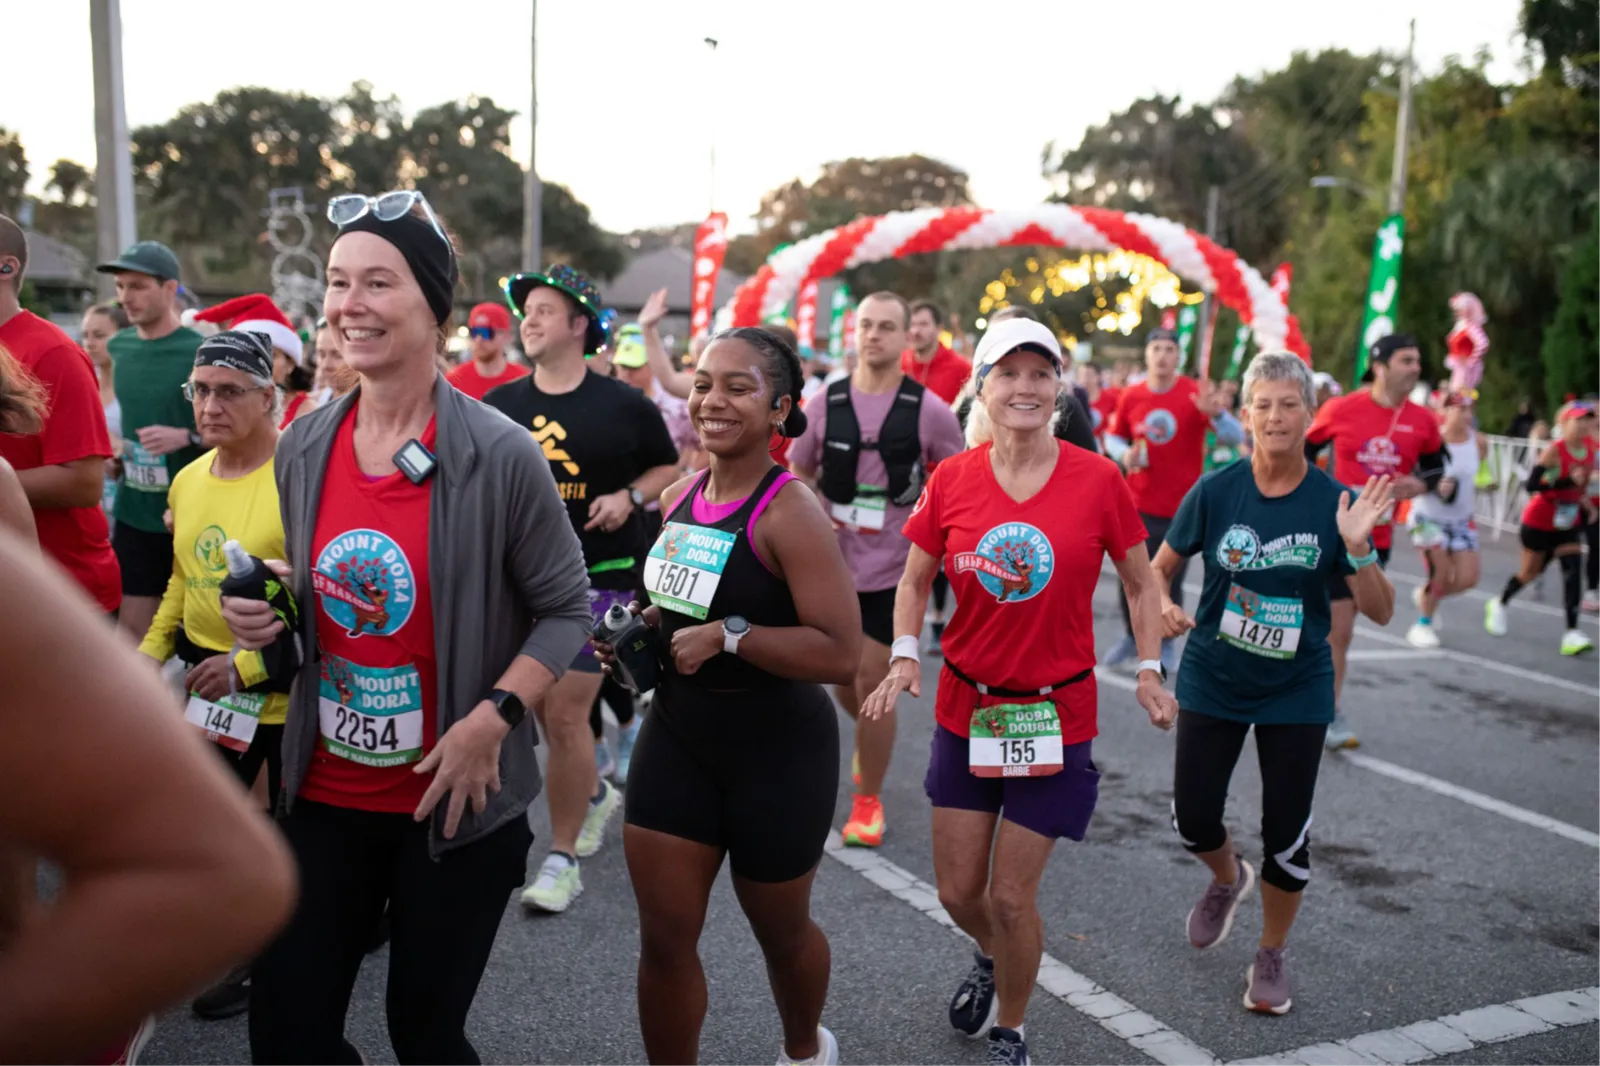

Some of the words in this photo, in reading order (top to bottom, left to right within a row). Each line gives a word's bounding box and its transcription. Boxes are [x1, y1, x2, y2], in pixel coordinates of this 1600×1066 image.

[686, 532, 733, 554] MOUNT
[980, 526, 1029, 556] MOUNT
[1029, 534, 1050, 573] DORA
[1261, 534, 1293, 558] MOUNT
[1295, 532, 1318, 547] DORA
[686, 547, 718, 567] DORA
[958, 555, 983, 571] HALF
[320, 534, 383, 574] MOUNT
[382, 548, 410, 603] DORA
[655, 562, 700, 600] 1501
[1260, 601, 1303, 614] MOUNT
[1265, 613, 1296, 625] DORA
[1239, 619, 1285, 649] 1479
[353, 672, 419, 693] MOUNT
[361, 691, 412, 710] DORA
[204, 706, 234, 734] 144
[1015, 708, 1052, 722] DORA
[335, 706, 399, 751] 2254
[1008, 720, 1060, 734] DOUBLE
[329, 744, 349, 758] HALF
[350, 753, 407, 767] MARATHON
[999, 739, 1036, 764] 155
[1002, 765, 1031, 777] BARBIE
